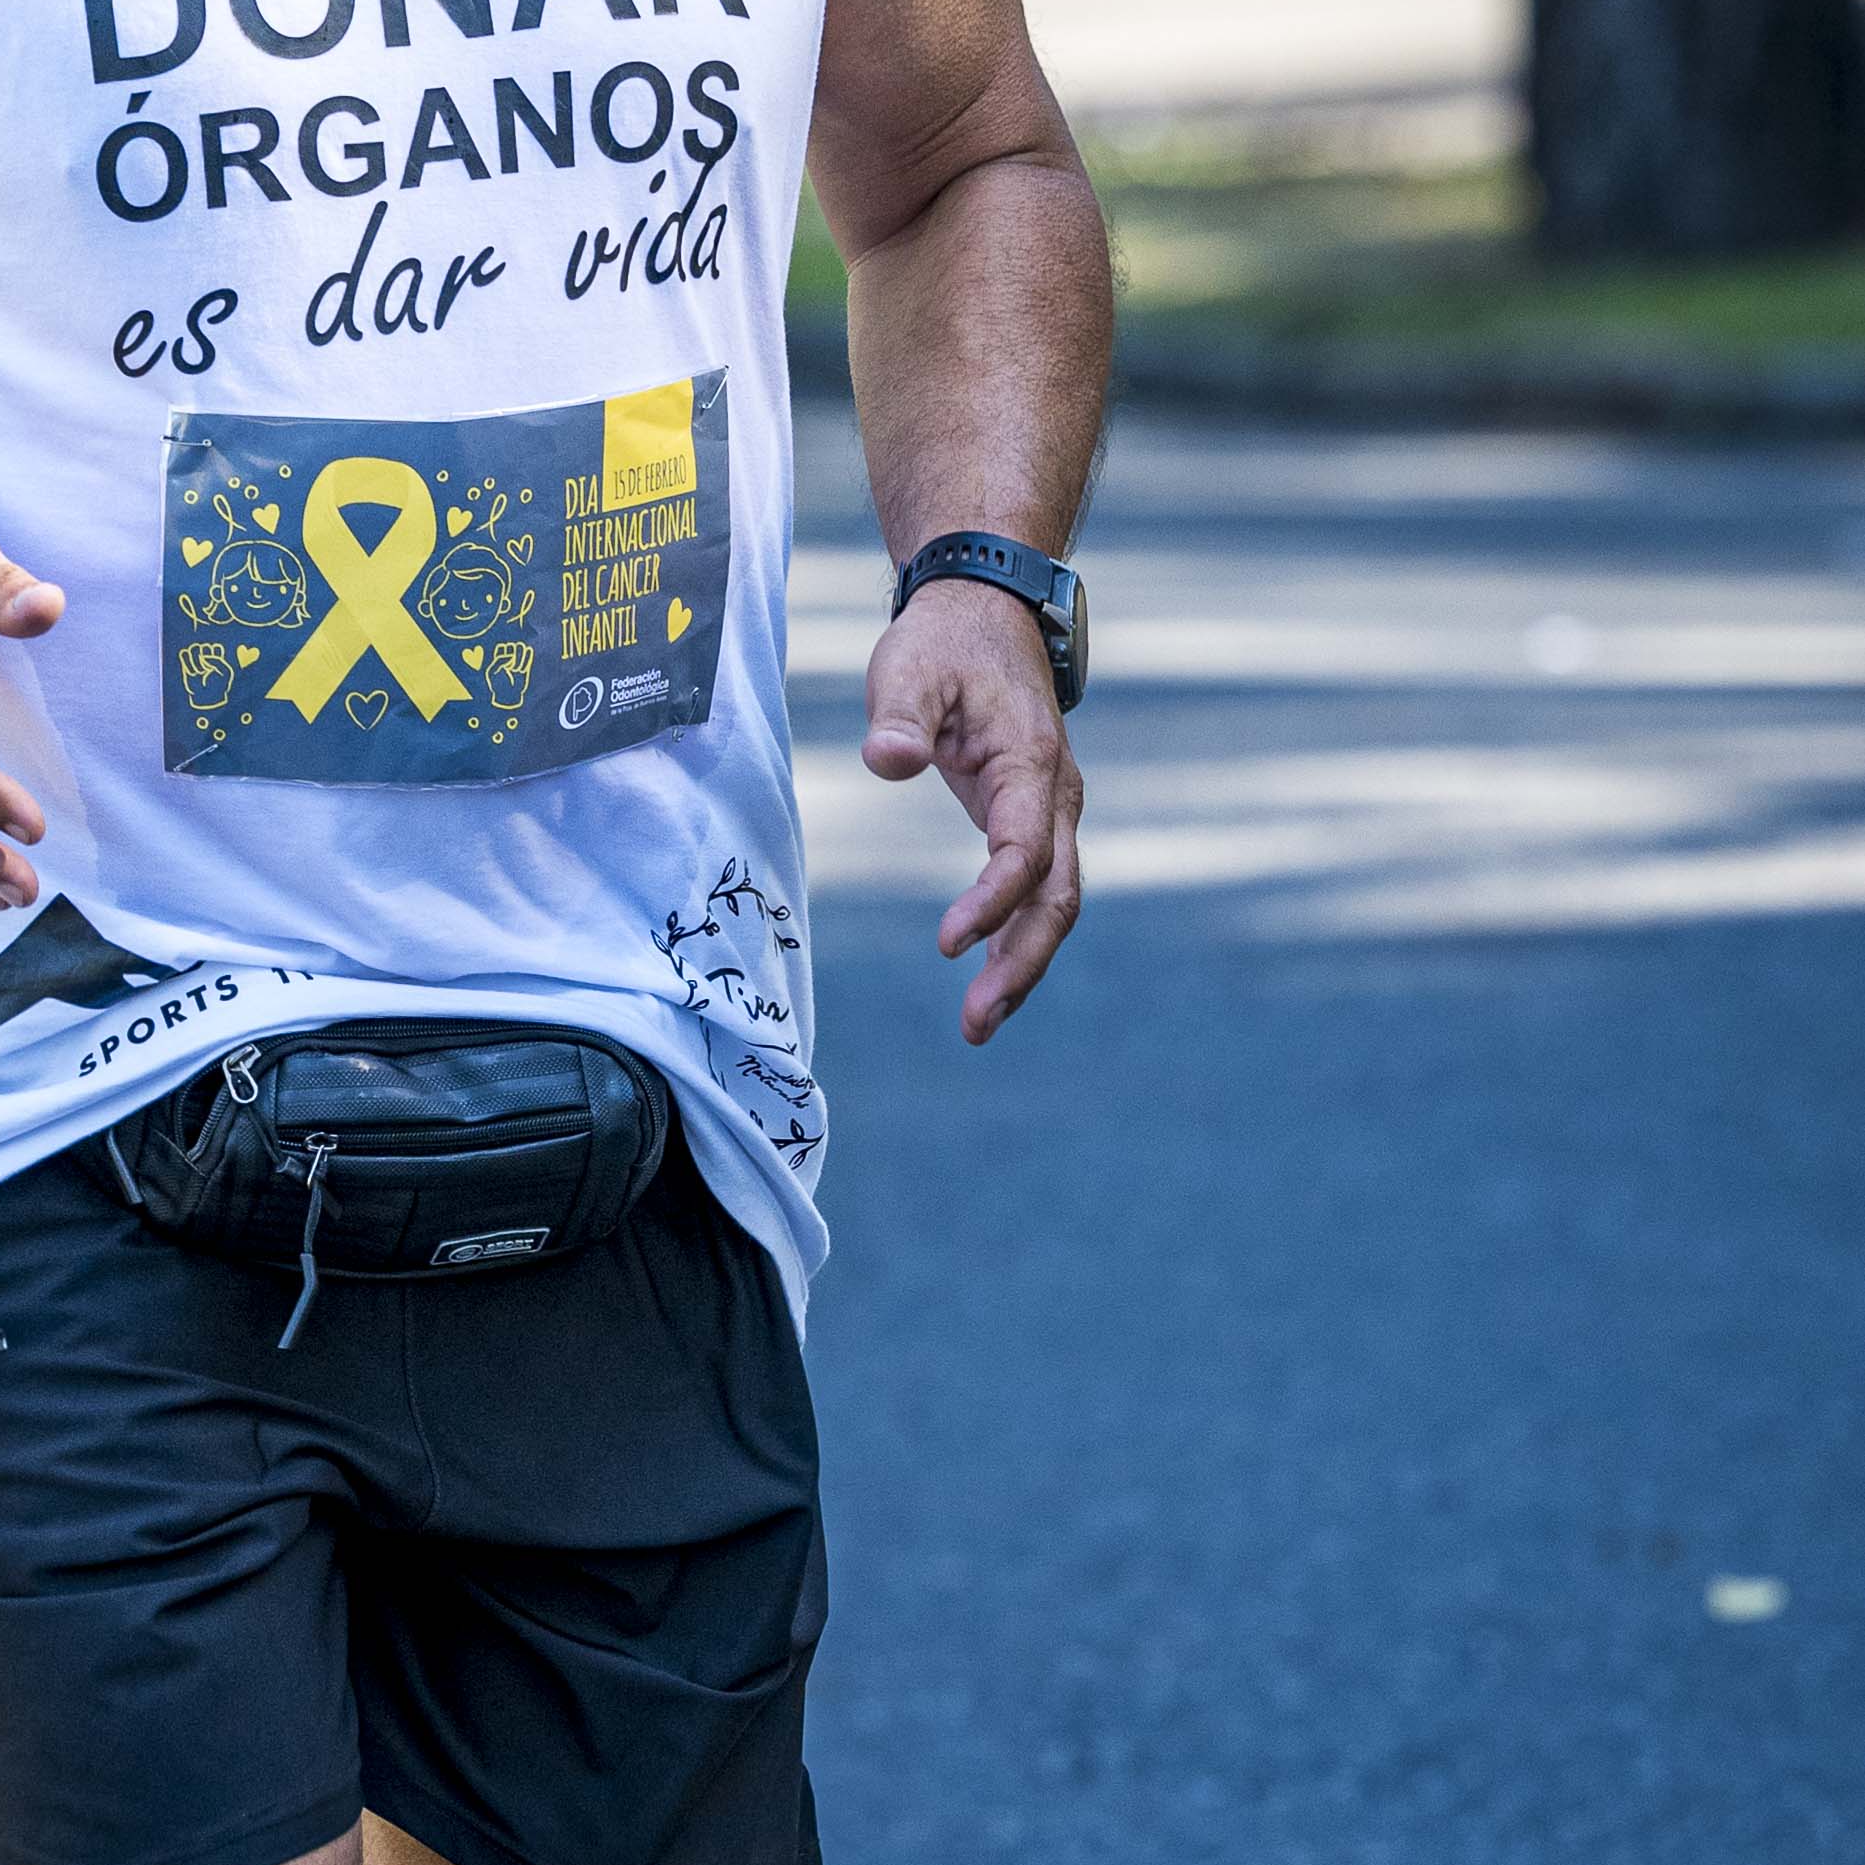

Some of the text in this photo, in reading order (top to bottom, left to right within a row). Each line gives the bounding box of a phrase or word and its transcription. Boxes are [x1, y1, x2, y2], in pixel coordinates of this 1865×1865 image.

[96, 61, 740, 223] ÓRGANOS
[113, 154, 728, 378] es dar vida
[565, 474, 598, 520] DIA
[614, 454, 687, 500] 15 DE FEBRERO
[563, 497, 698, 566] INTERNACIONAL
[562, 552, 661, 613] DEL CANCER
[561, 604, 638, 660] INFANTIL
[610, 679, 669, 703] Odontológica
[611, 668, 661, 690] Federación
[78, 974, 239, 1077] SPORTS
